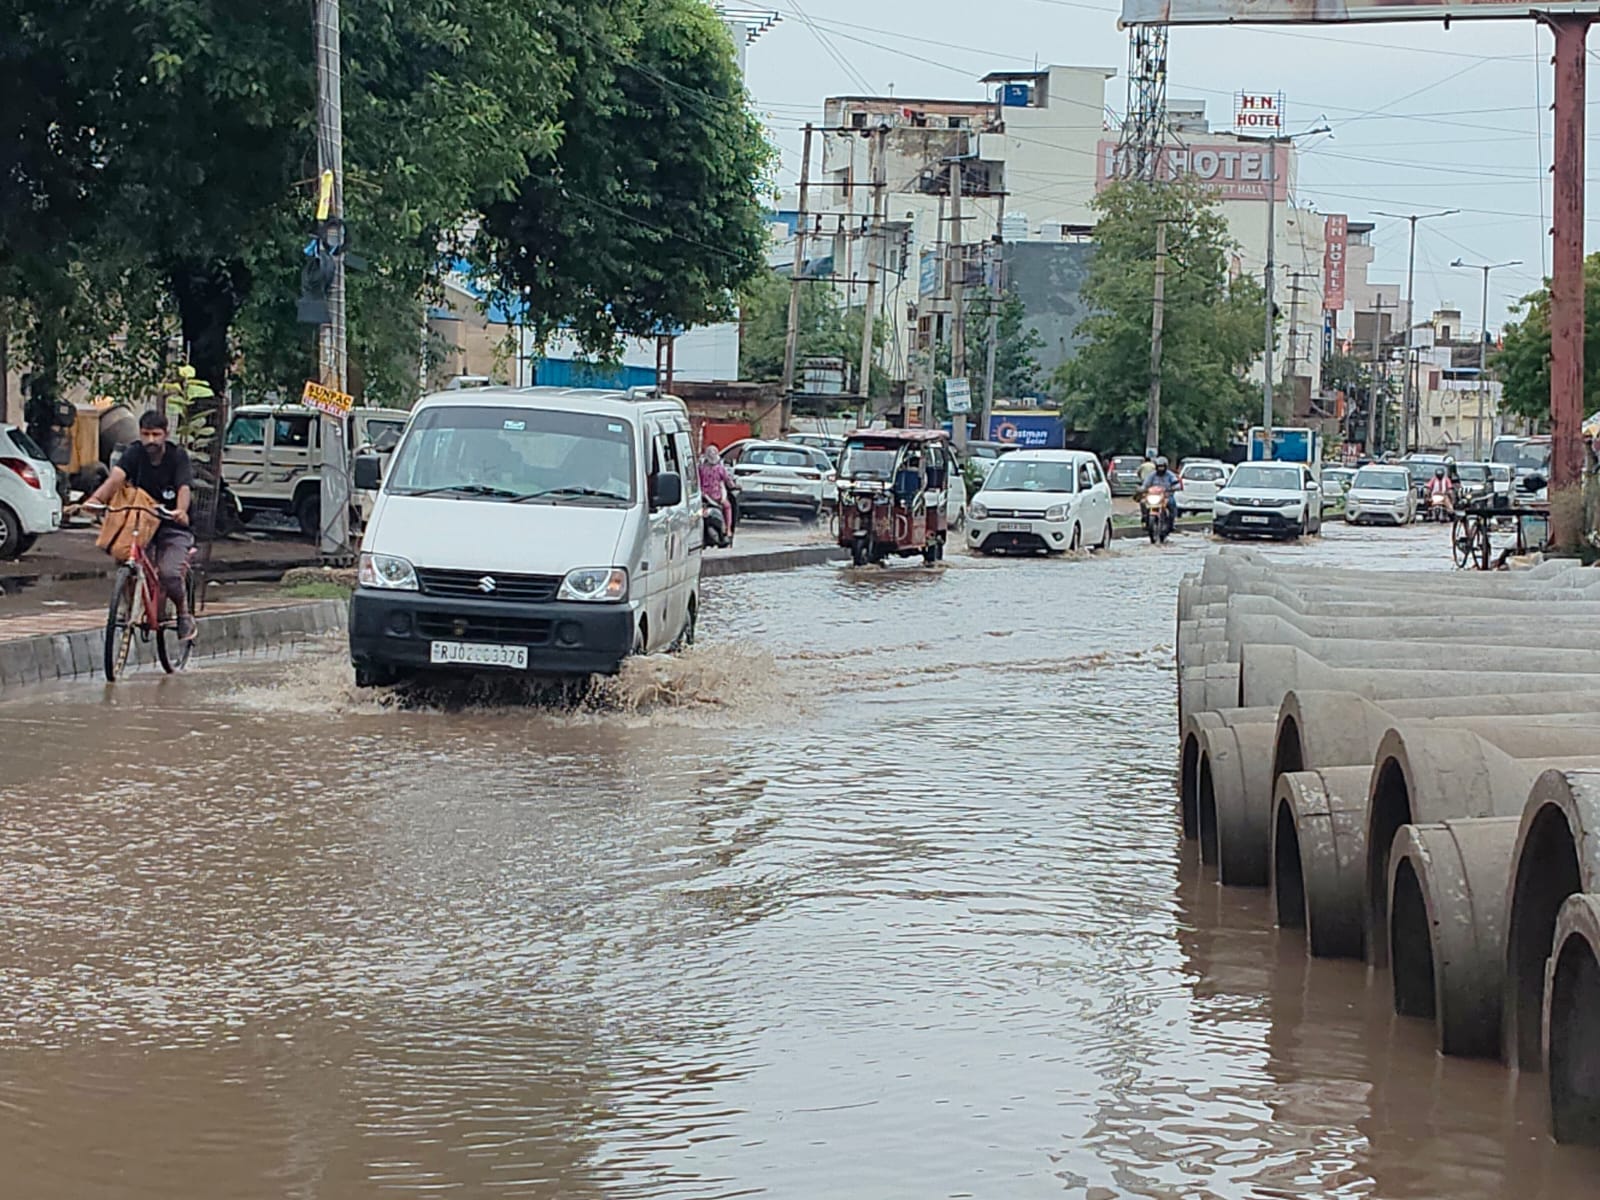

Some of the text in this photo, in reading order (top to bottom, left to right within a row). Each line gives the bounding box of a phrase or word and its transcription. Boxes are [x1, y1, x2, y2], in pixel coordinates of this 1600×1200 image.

[1237, 114, 1281, 126] HOTEL
[1168, 150, 1279, 181] HOTEL
[1237, 183, 1264, 195] HALL
[1330, 243, 1342, 290] HOTEL
[308, 385, 351, 405] SUNPAC
[1005, 429, 1048, 438] Eastman
